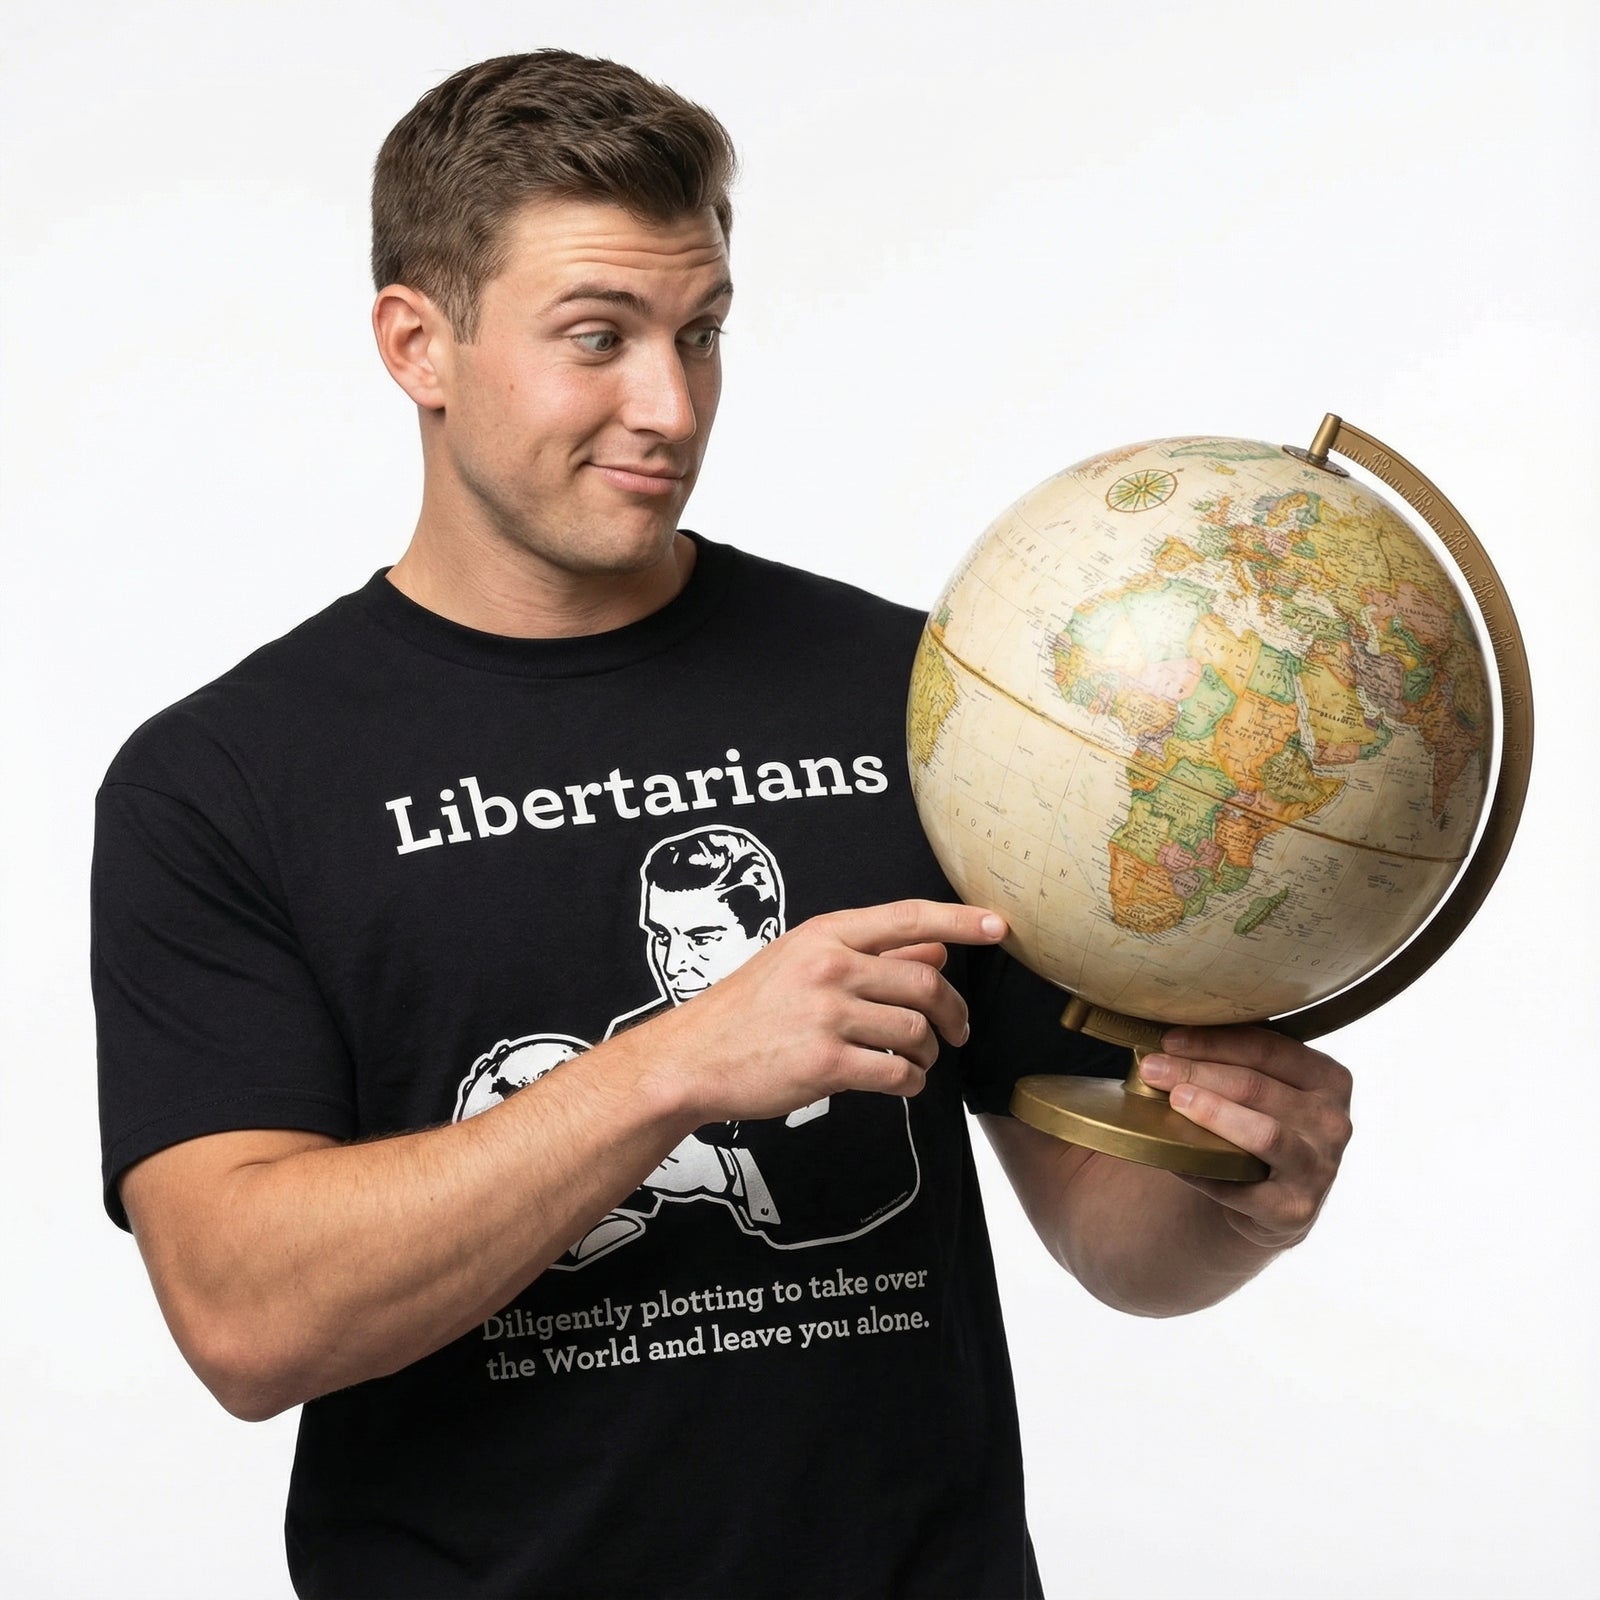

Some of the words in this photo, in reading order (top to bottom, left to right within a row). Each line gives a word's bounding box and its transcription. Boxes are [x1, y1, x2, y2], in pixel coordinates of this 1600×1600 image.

[385, 748, 888, 855] Libertarians
[483, 1298, 633, 1341] Diligently
[640, 1285, 764, 1327] plotting
[772, 1281, 802, 1303] to
[809, 1268, 868, 1299] take
[875, 1269, 928, 1292] over
[486, 1352, 536, 1380] the
[542, 1335, 641, 1375] World
[648, 1326, 706, 1361] and
[711, 1324, 792, 1353] leave
[799, 1319, 850, 1349] you
[857, 1305, 930, 1335] alone.
